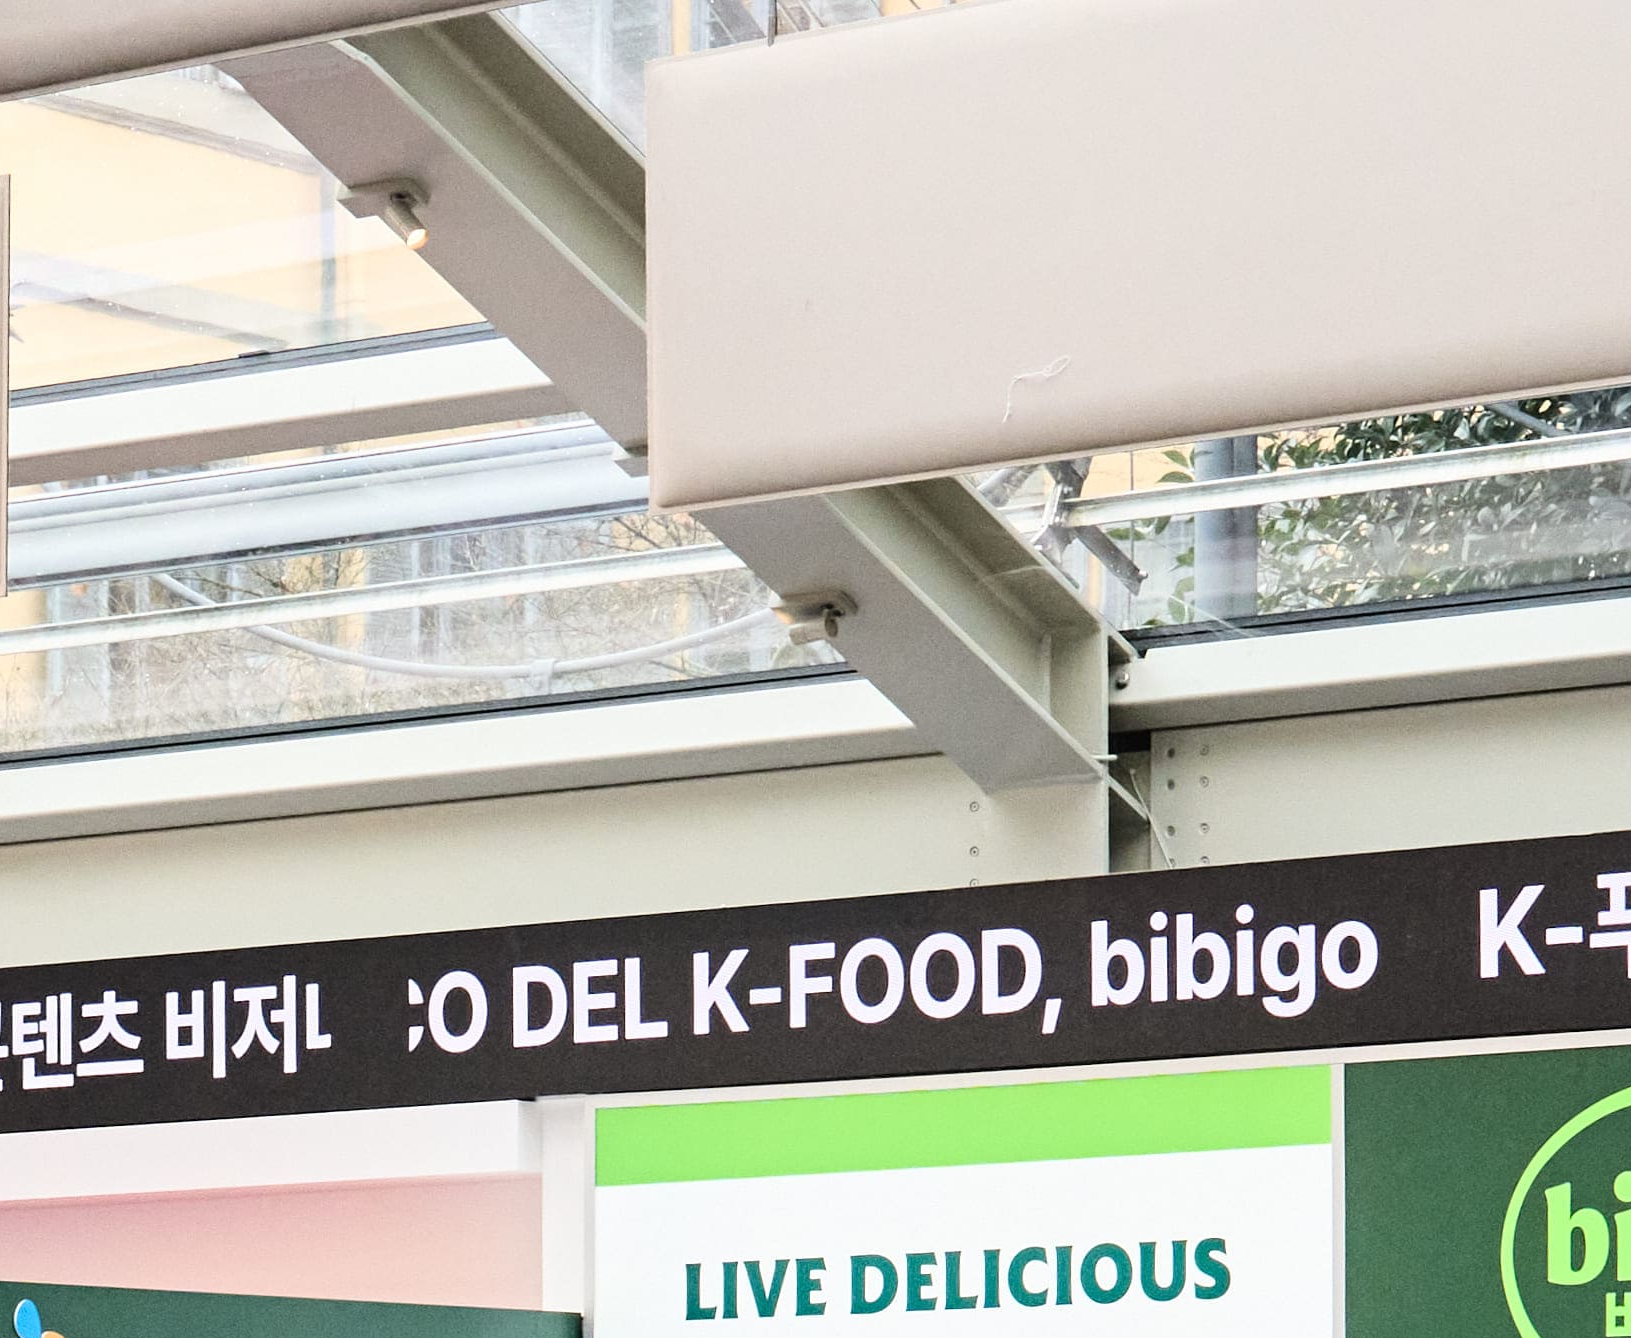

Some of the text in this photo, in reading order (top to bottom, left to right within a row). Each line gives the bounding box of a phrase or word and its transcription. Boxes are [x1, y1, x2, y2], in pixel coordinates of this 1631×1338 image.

[513, 903, 1379, 1047] DEL K-FOOD, bibigo
[685, 1236, 1231, 1321] LIVE DELICIOUS
